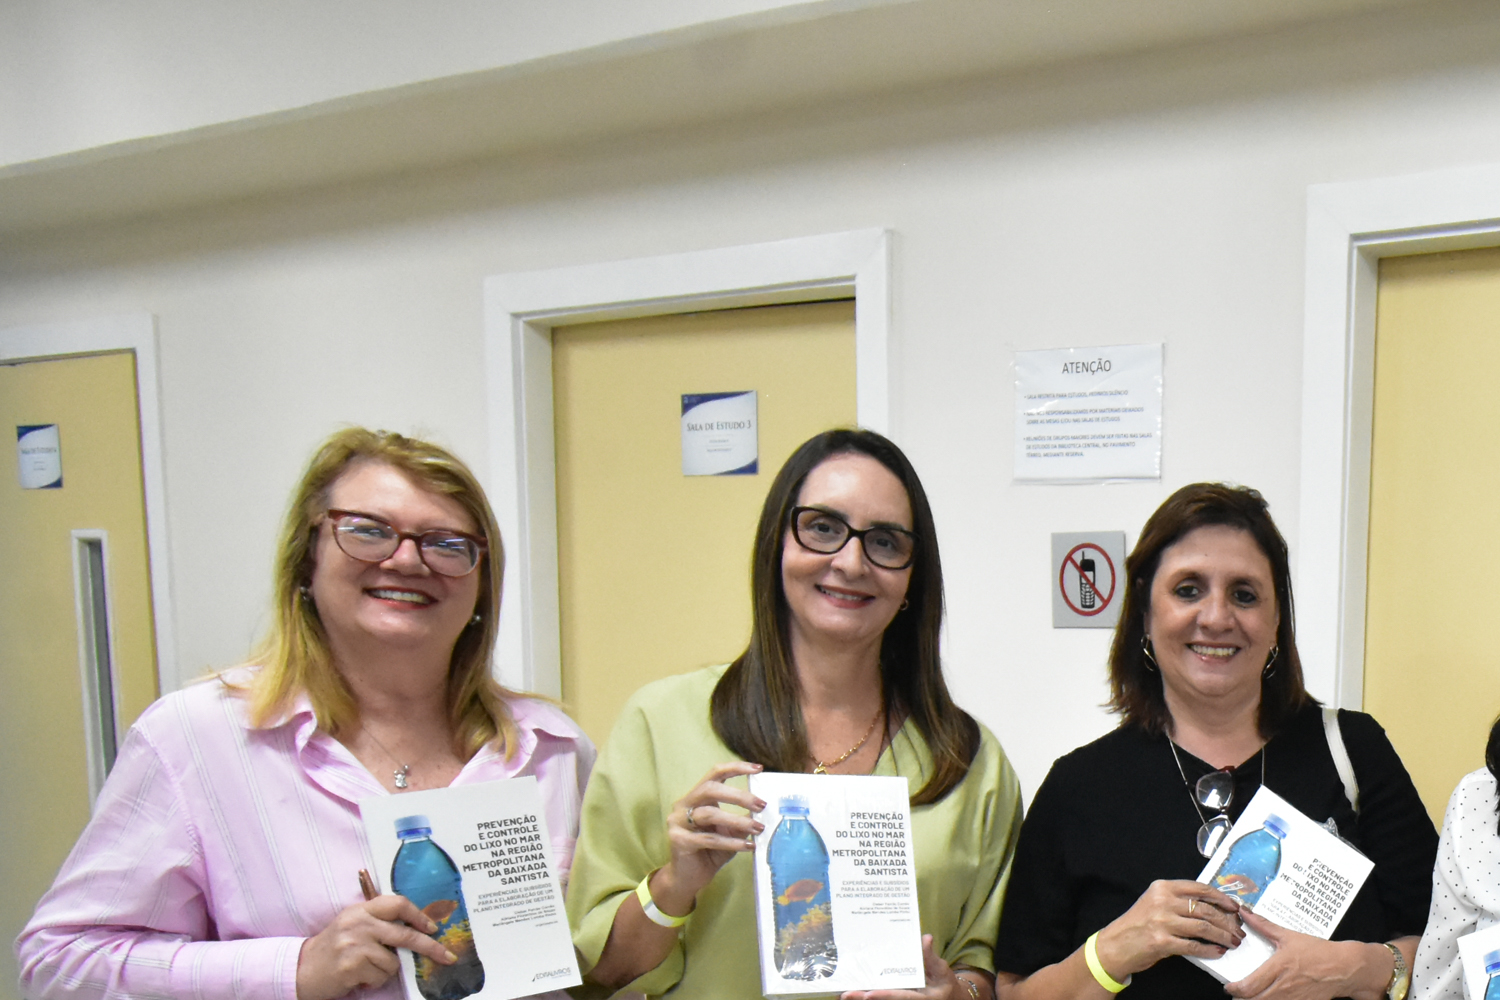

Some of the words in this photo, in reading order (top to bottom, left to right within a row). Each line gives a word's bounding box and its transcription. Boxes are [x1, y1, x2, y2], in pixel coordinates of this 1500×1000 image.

[1062, 358, 1111, 375] ATENÇÃO
[687, 422, 703, 431] SALA
[705, 422, 714, 430] DE
[717, 421, 744, 430] ESTUDO
[747, 420, 751, 429] 3
[477, 815, 536, 830] PREVENÇÃO
[850, 812, 903, 821] PREVENÇÃO
[487, 825, 539, 839] CONTROLE
[464, 844, 478, 852] DO
[479, 840, 502, 850] LIXO
[504, 838, 518, 846] NO
[519, 834, 541, 844] MAR
[491, 849, 506, 858] NA
[507, 842, 543, 855] REGIÃO
[874, 839, 905, 848] REGIÃO
[463, 852, 545, 872] METROPOLITANA
[488, 869, 502, 878] DA
[503, 862, 547, 875] BAIXADA
[501, 871, 549, 886] SANTISTA
[1313, 868, 1350, 896] CONTROLE
[1305, 880, 1317, 891] NA
[1316, 888, 1342, 909] REGIÃO
[1319, 881, 1330, 891] NO
[1330, 888, 1346, 902] MAR
[1291, 890, 1303, 900] DA
[1302, 897, 1334, 922] BAIXADA
[1294, 901, 1330, 928] SANTISTA
